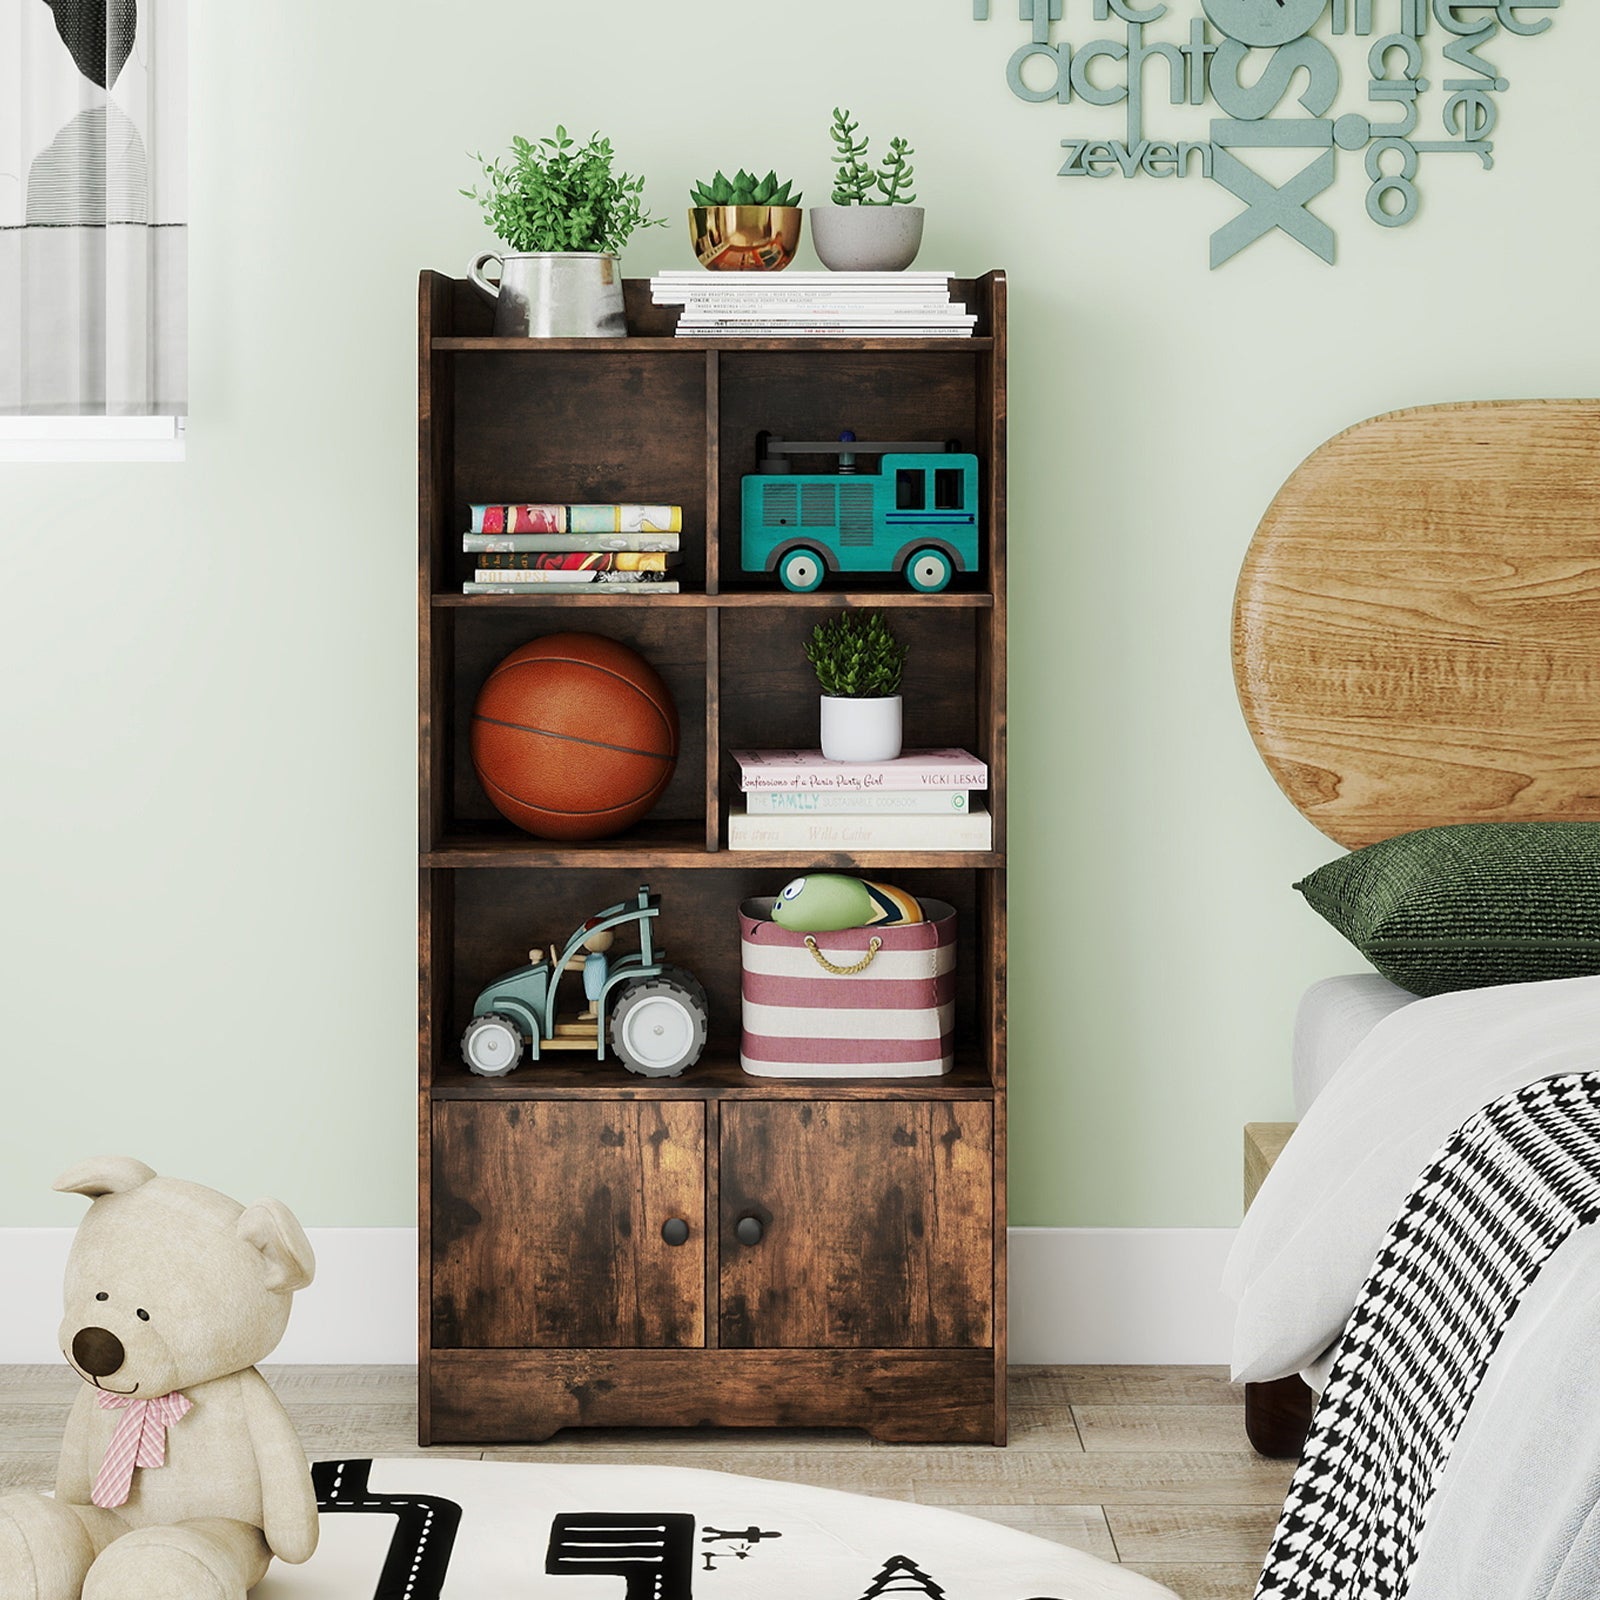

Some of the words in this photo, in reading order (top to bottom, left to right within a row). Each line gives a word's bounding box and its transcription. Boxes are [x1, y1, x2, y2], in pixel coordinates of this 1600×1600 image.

[1006, 18, 1218, 108] acht
[1421, 21, 1510, 170] vier
[1364, 32, 1430, 228] cinco
[1057, 138, 1214, 178] zeven
[479, 571, 549, 583] COLLAPSE
[790, 774, 801, 788] of
[809, 774, 833, 788] Paris
[836, 774, 861, 790] Party
[863, 773, 883, 788] Girl
[921, 774, 950, 785] VICKI
[771, 793, 819, 810] FAMILY
[823, 796, 873, 807] SUSTAINABLE
[875, 796, 917, 807] COOKBOOK
[809, 825, 838, 841] Willa
